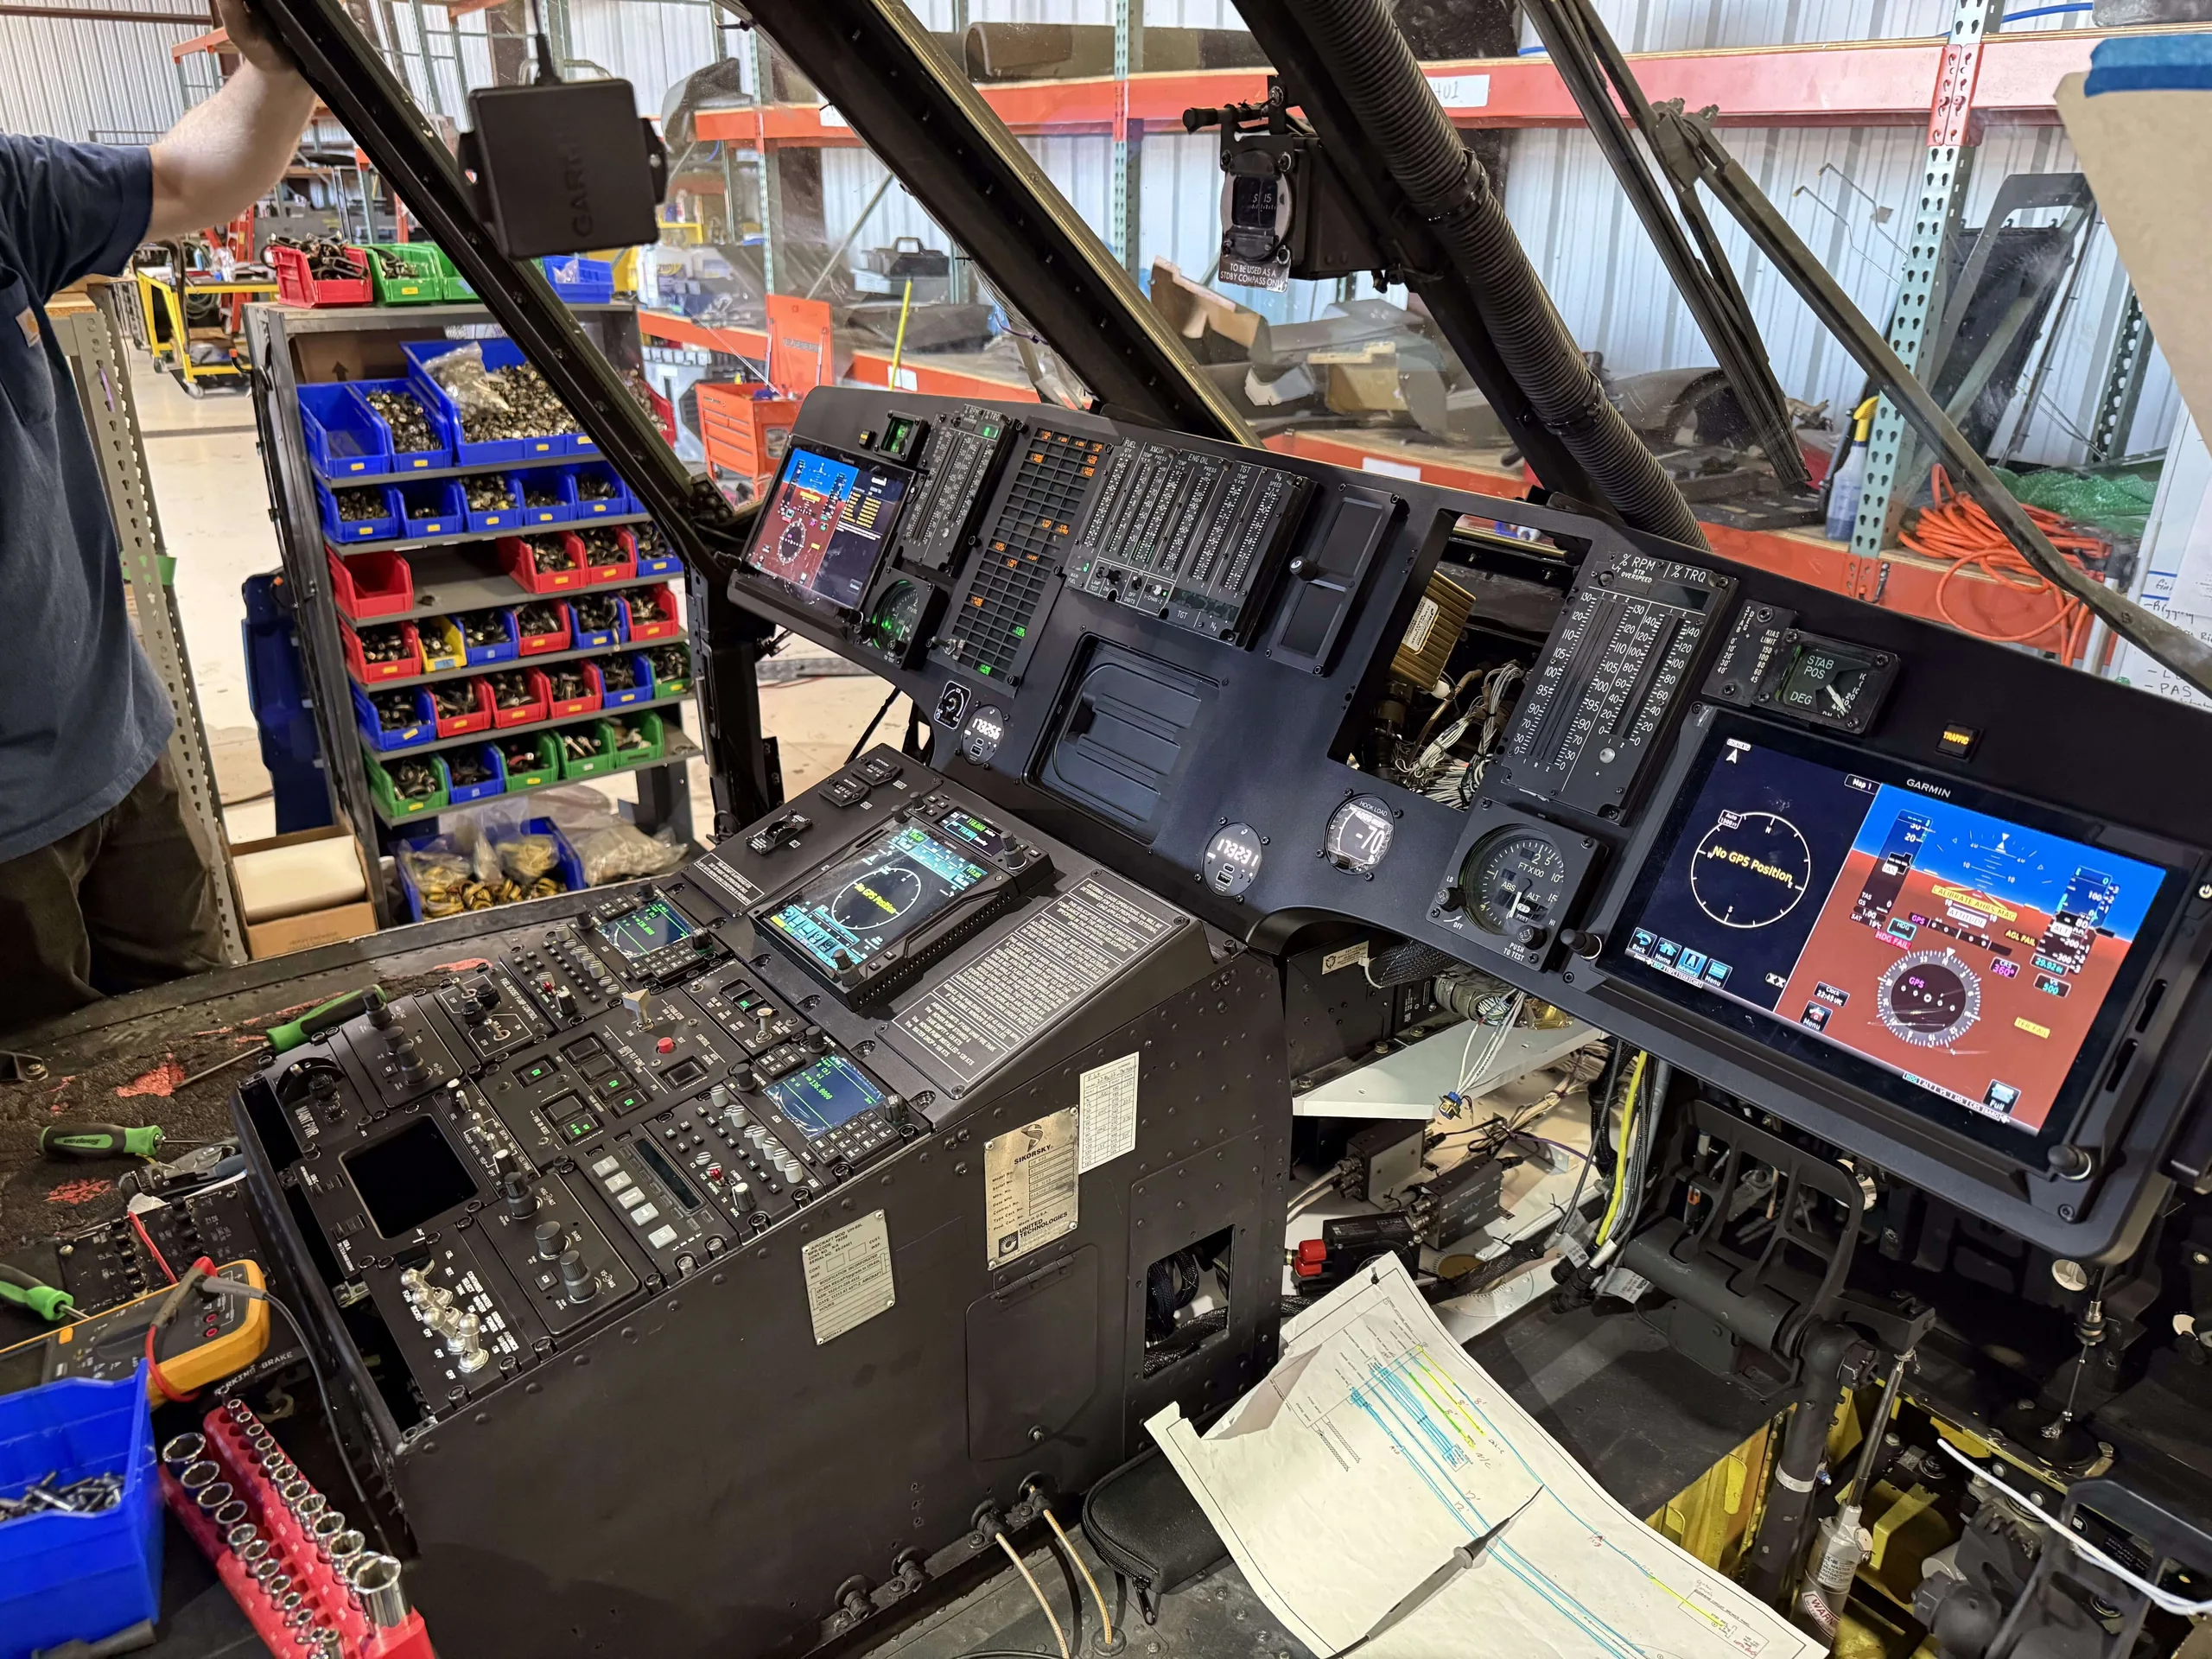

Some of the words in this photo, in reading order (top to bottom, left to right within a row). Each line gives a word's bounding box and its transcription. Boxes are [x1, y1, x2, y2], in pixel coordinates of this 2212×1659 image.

[1230, 263, 1239, 272] TO
[1239, 264, 1247, 273] BE
[1247, 265, 1262, 275] USED
[1262, 267, 1271, 276] AS
[1271, 269, 1276, 277] A
[1220, 270, 1238, 281] STDBY
[1237, 272, 1267, 286] COMPASS
[1123, 439, 1136, 449] FUEL
[1149, 445, 1166, 454] XMSN
[1187, 454, 1200, 463] ENG
[1239, 465, 1252, 474] TGT
[1631, 556, 1656, 572] RPM
[1620, 571, 1653, 584] OVERSPEED
[1633, 568, 1645, 576] RTR
[1683, 567, 1707, 584] TRQ
[1580, 592, 1592, 602] 130
[1177, 609, 1189, 620] TGT
[1572, 611, 1584, 621] 120
[1631, 605, 1644, 615] 130
[1643, 616, 1656, 626] 140
[1561, 630, 1575, 640] 110
[1623, 624, 1636, 634] 120
[1686, 627, 1700, 638] 140
[1765, 629, 1780, 639] KIAS
[1635, 632, 1649, 641] 120
[1759, 636, 1777, 645] LIMIT
[1553, 648, 1567, 659] 105
[1614, 643, 1627, 654] 110
[1678, 643, 1692, 653] 120
[1762, 645, 1773, 654] 150
[1604, 661, 1618, 674] 105
[1622, 663, 1634, 673] 80
[1671, 659, 1685, 669] 100
[1757, 660, 1766, 669] 80
[1807, 655, 1834, 670] STAB
[1543, 667, 1558, 678] 100
[1803, 665, 1826, 680] POS
[1615, 678, 1627, 689] 60
[1663, 675, 1675, 684] 80
[1750, 675, 1759, 683] 45
[1535, 684, 1549, 696] 95
[1595, 680, 1609, 692] 100
[1789, 691, 1813, 706] DEG
[1527, 703, 1541, 715] 90
[1586, 700, 1600, 712] 95
[1521, 718, 1531, 728] 70
[1514, 734, 1524, 743] 30
[1942, 730, 1970, 746] TRAFFIC
[1852, 778, 1866, 788] Map
[1906, 778, 1951, 798] GARMIN
[1359, 799, 1376, 812] HOOK
[1373, 805, 1389, 817] LOAD
[1531, 853, 1541, 864] 2
[1544, 857, 1552, 867] 5
[1712, 845, 1727, 860] No
[1728, 852, 1751, 868] GPS
[1751, 860, 1794, 883] Position
[1517, 862, 1529, 872] FT
[1446, 874, 1454, 883] LO
[1500, 880, 1516, 893] ABS
[1526, 892, 1541, 903] ALT
[1861, 891, 1872, 900] TAS
[1932, 886, 1974, 906] CALIBRATE
[1516, 913, 1529, 923] FEET
[1911, 914, 1926, 925] GPS
[1948, 909, 1985, 926] ATTITUDE
[1452, 920, 1464, 931] OFF
[1875, 931, 1892, 944] HDG
[1891, 937, 1910, 950] FAIL
[2005, 930, 2020, 942] AGL
[2020, 935, 2037, 947] FAIL
[1509, 942, 1525, 954] PUSH
[1631, 943, 1646, 955] Back
[1503, 947, 1512, 956] TO
[1510, 950, 1525, 962] TEST
[1655, 952, 1671, 966] Home
[1999, 959, 2012, 969] CRS
[2034, 957, 2057, 970] 29.92
[1993, 963, 2015, 977] 360°
[1705, 974, 1721, 988] Menu
[1908, 976, 1926, 988] GPS
[2042, 982, 2059, 995] 500
[499, 977, 511, 988] FUEL
[506, 985, 520, 998] BOOST
[515, 994, 527, 1006] PUMP
[522, 1004, 538, 1021] CONTROL
[1802, 1017, 1821, 1031] Menu
[2016, 1020, 2031, 1030] TER
[2031, 1024, 2049, 1037] FAIL
[1988, 1100, 2005, 1111] Full
[1013, 1142, 1051, 1166] SIKORSKY
[1019, 1211, 1067, 1239] TECHNOLOGIES
[1019, 1217, 1043, 1234] UNITED
[810, 1236, 834, 1250] AIRCRAFT
[834, 1230, 845, 1239] MOD
[818, 1268, 847, 1285] MODIFICATION
[847, 1252, 878, 1271] INCORPORATED
[461, 1277, 475, 1294] SELECT
[466, 1270, 484, 1294] CONTAINER
[454, 1283, 467, 1297] TANK
[473, 1295, 487, 1313] MASTER
[480, 1292, 494, 1310] WATER
[410, 1305, 423, 1322] BUCKET
[485, 1315, 499, 1333] POWER
[423, 1328, 434, 1338] OFF
[496, 1335, 512, 1355] MASTER
[434, 1348, 445, 1359] OFF
[260, 1351, 294, 1370] BRAKE
[445, 1369, 456, 1380] OFF
